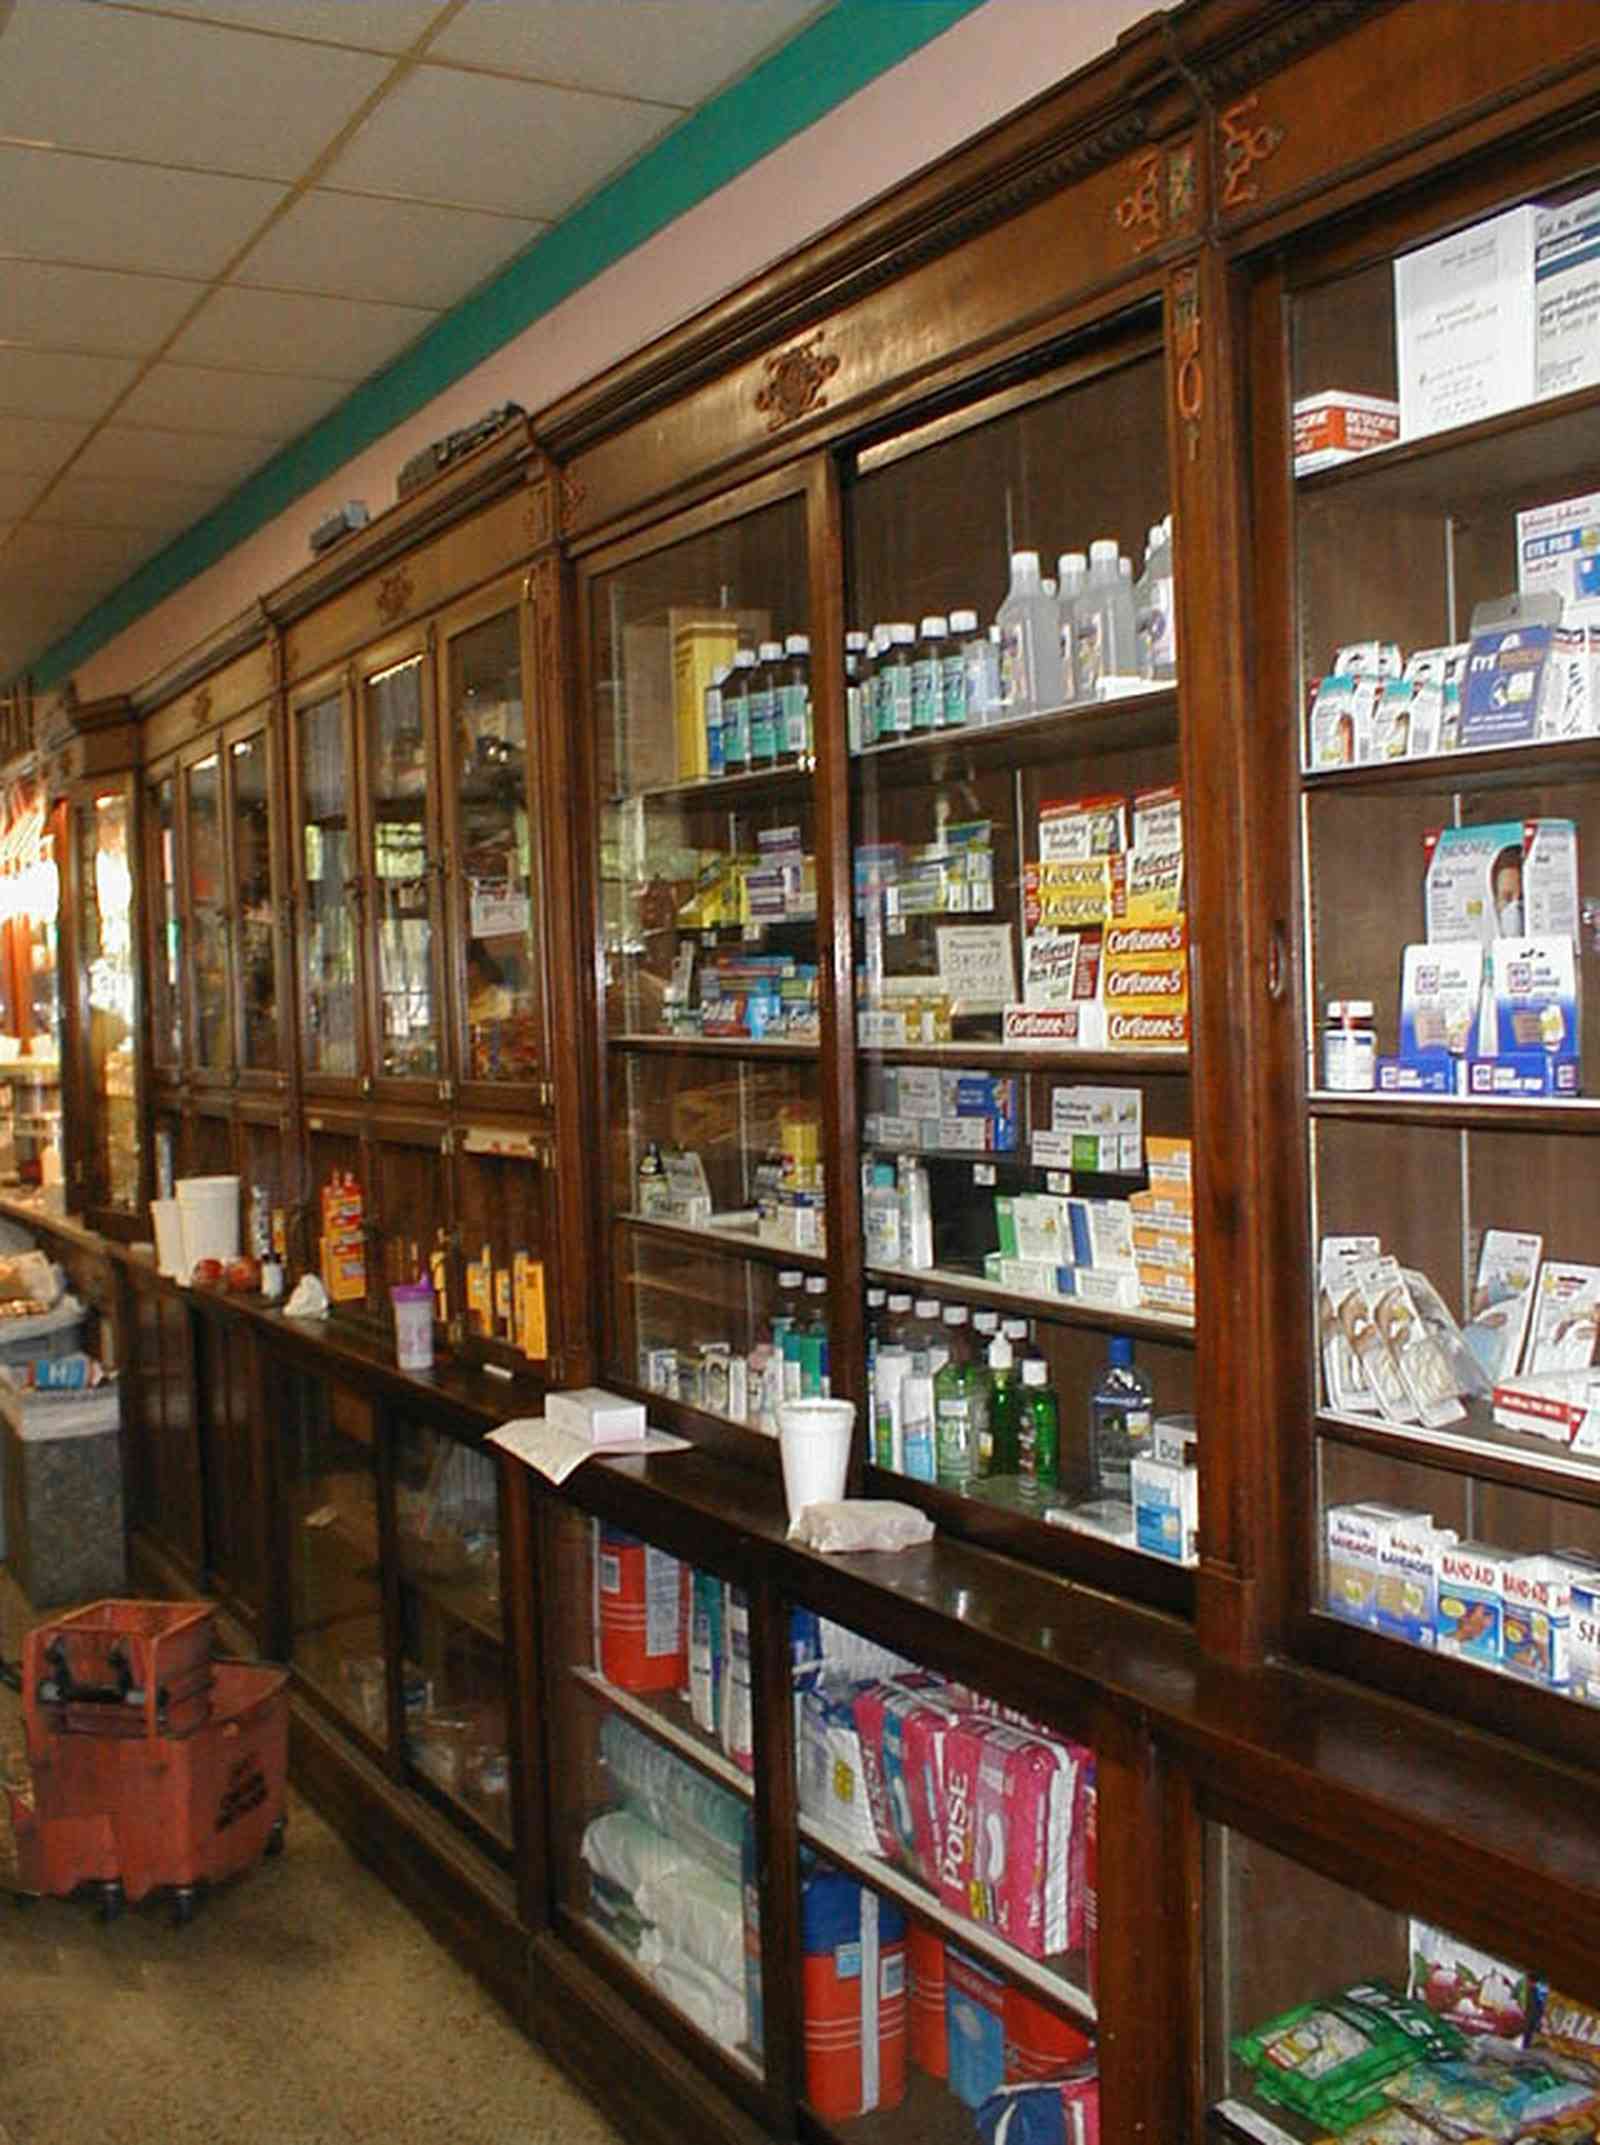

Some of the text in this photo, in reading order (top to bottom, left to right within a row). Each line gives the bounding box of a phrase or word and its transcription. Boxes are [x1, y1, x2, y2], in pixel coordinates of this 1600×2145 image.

[1108, 928, 1181, 954] Cortizone-5
[1108, 970, 1181, 996] Cortizone-5
[1111, 1016, 1184, 1037] Cortizone-5
[942, 1770, 969, 1891] POISE
